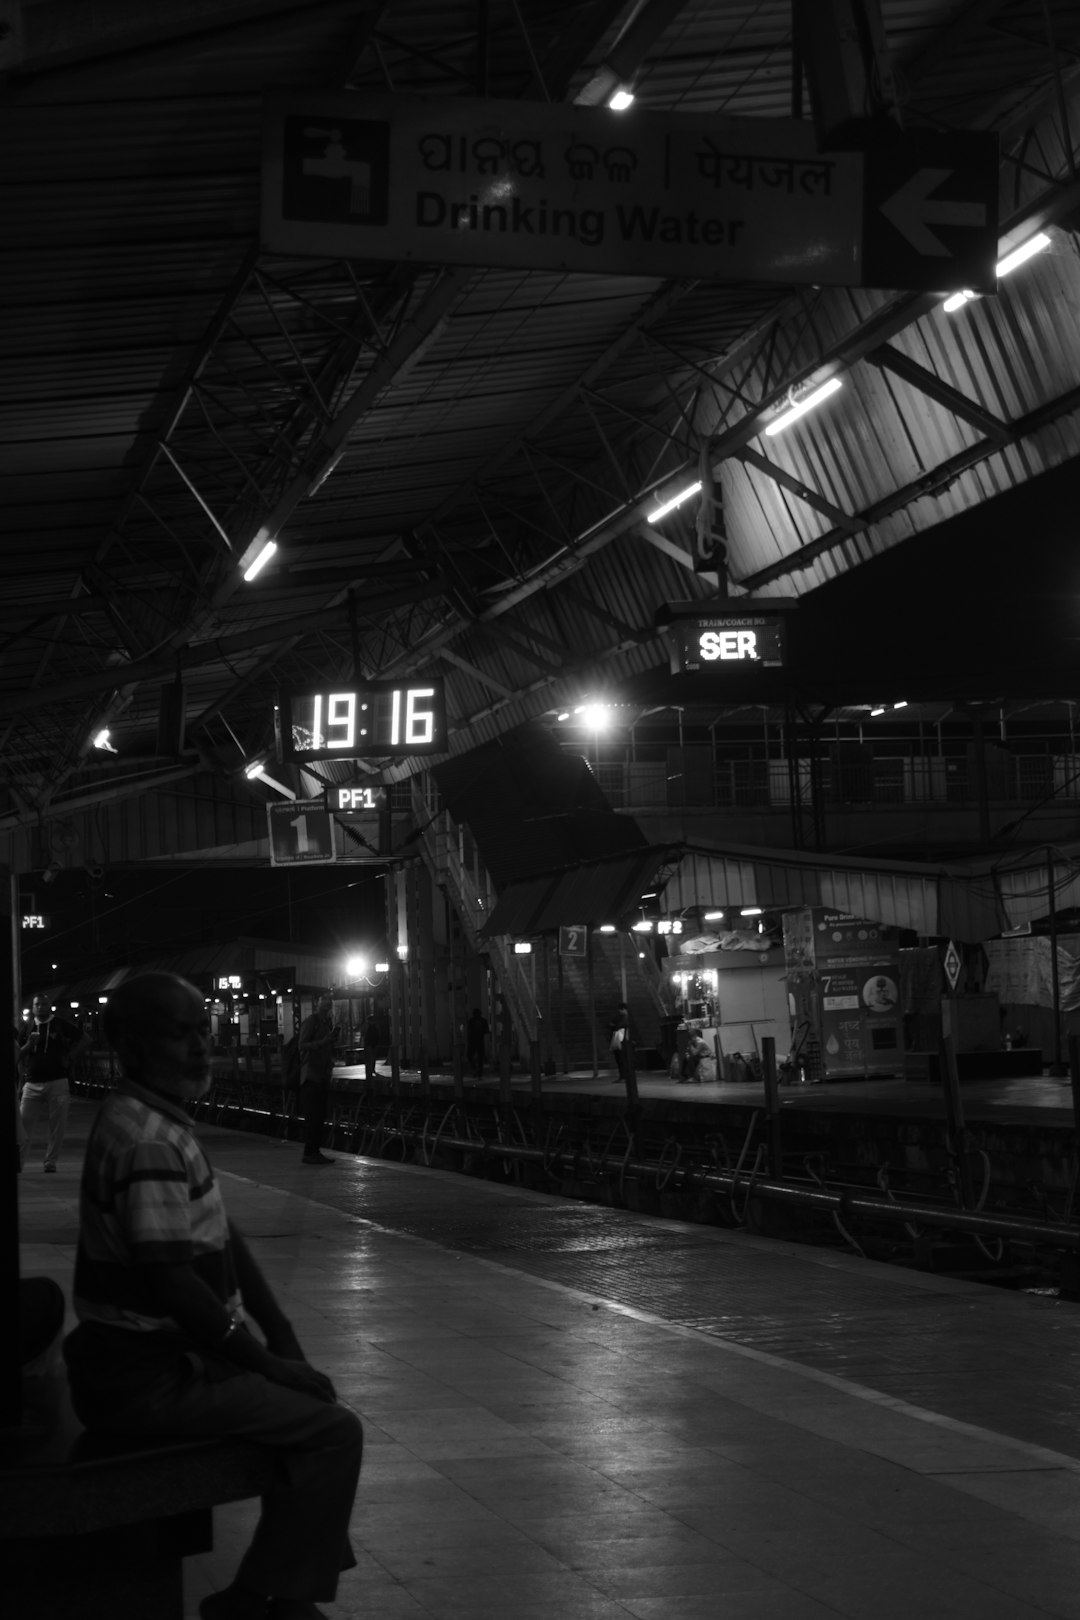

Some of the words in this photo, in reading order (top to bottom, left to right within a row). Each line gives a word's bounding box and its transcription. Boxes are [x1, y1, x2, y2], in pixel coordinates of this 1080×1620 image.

[564, 143, 638, 182] ଜଳ
[695, 135, 836, 196] पेयजल
[416, 190, 605, 247] Drinking
[616, 204, 745, 246] Water
[698, 630, 758, 660] SER
[312, 687, 435, 750] 19:16
[338, 788, 376, 809] PF1
[290, 814, 309, 853] 1
[22, 915, 45, 929] PF1
[567, 931, 578, 950] 2
[821, 975, 832, 994] 7
